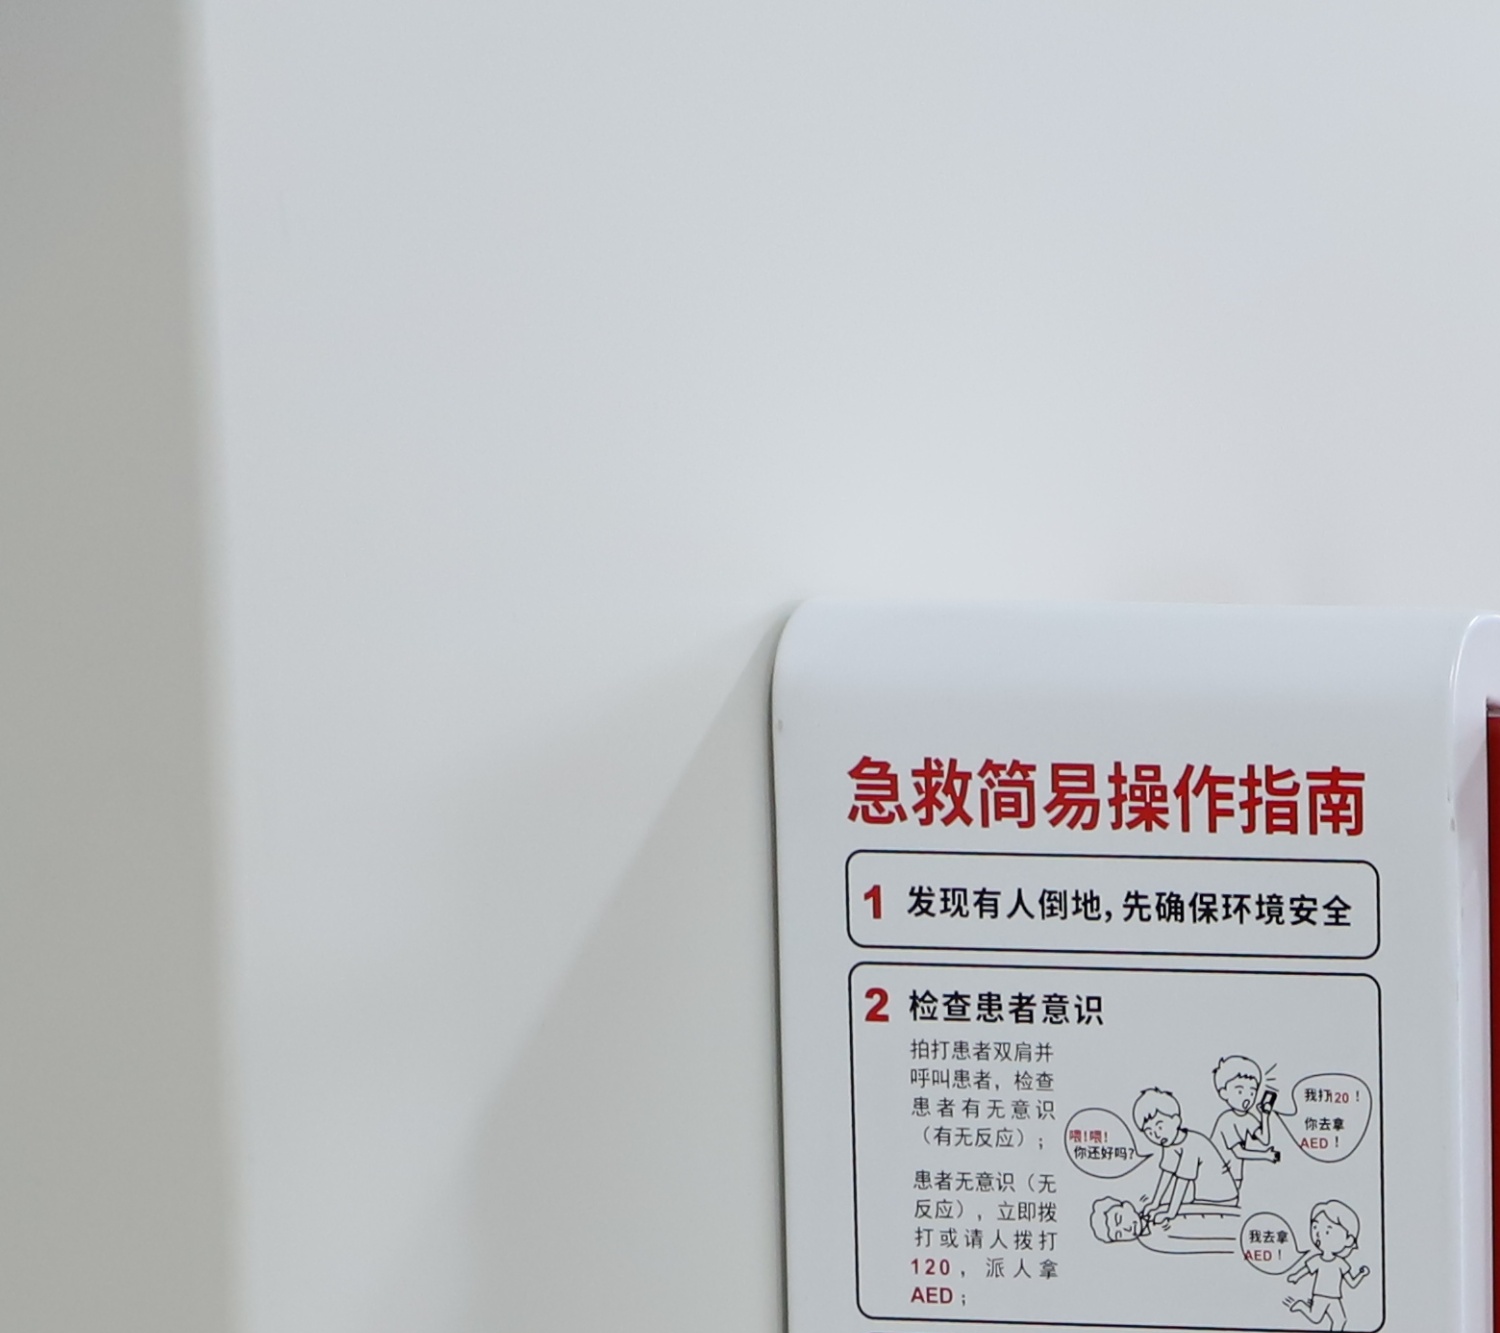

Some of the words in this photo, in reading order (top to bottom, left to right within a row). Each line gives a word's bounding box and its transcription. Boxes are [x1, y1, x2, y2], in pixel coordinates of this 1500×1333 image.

[848, 756, 1365, 836] 急救简易操作指南
[864, 885, 881, 919] 1
[865, 988, 889, 1022] 2
[909, 990, 1103, 1025] 检查患者意识
[910, 1039, 1053, 1062] 拍打患者双肩并
[911, 1068, 1053, 1091] 呼叫患者，检查
[912, 1096, 1055, 1120] 患者有无意识
[1305, 1117, 1344, 1131] 你去拿
[924, 1126, 1043, 1150] （有无反应）；
[914, 1170, 1056, 1193] 患者无意识（无
[915, 1199, 1057, 1222] 反应），立即拨
[915, 1227, 1057, 1251] 打或请人拨打
[1250, 1226, 1292, 1244] 我去拿
